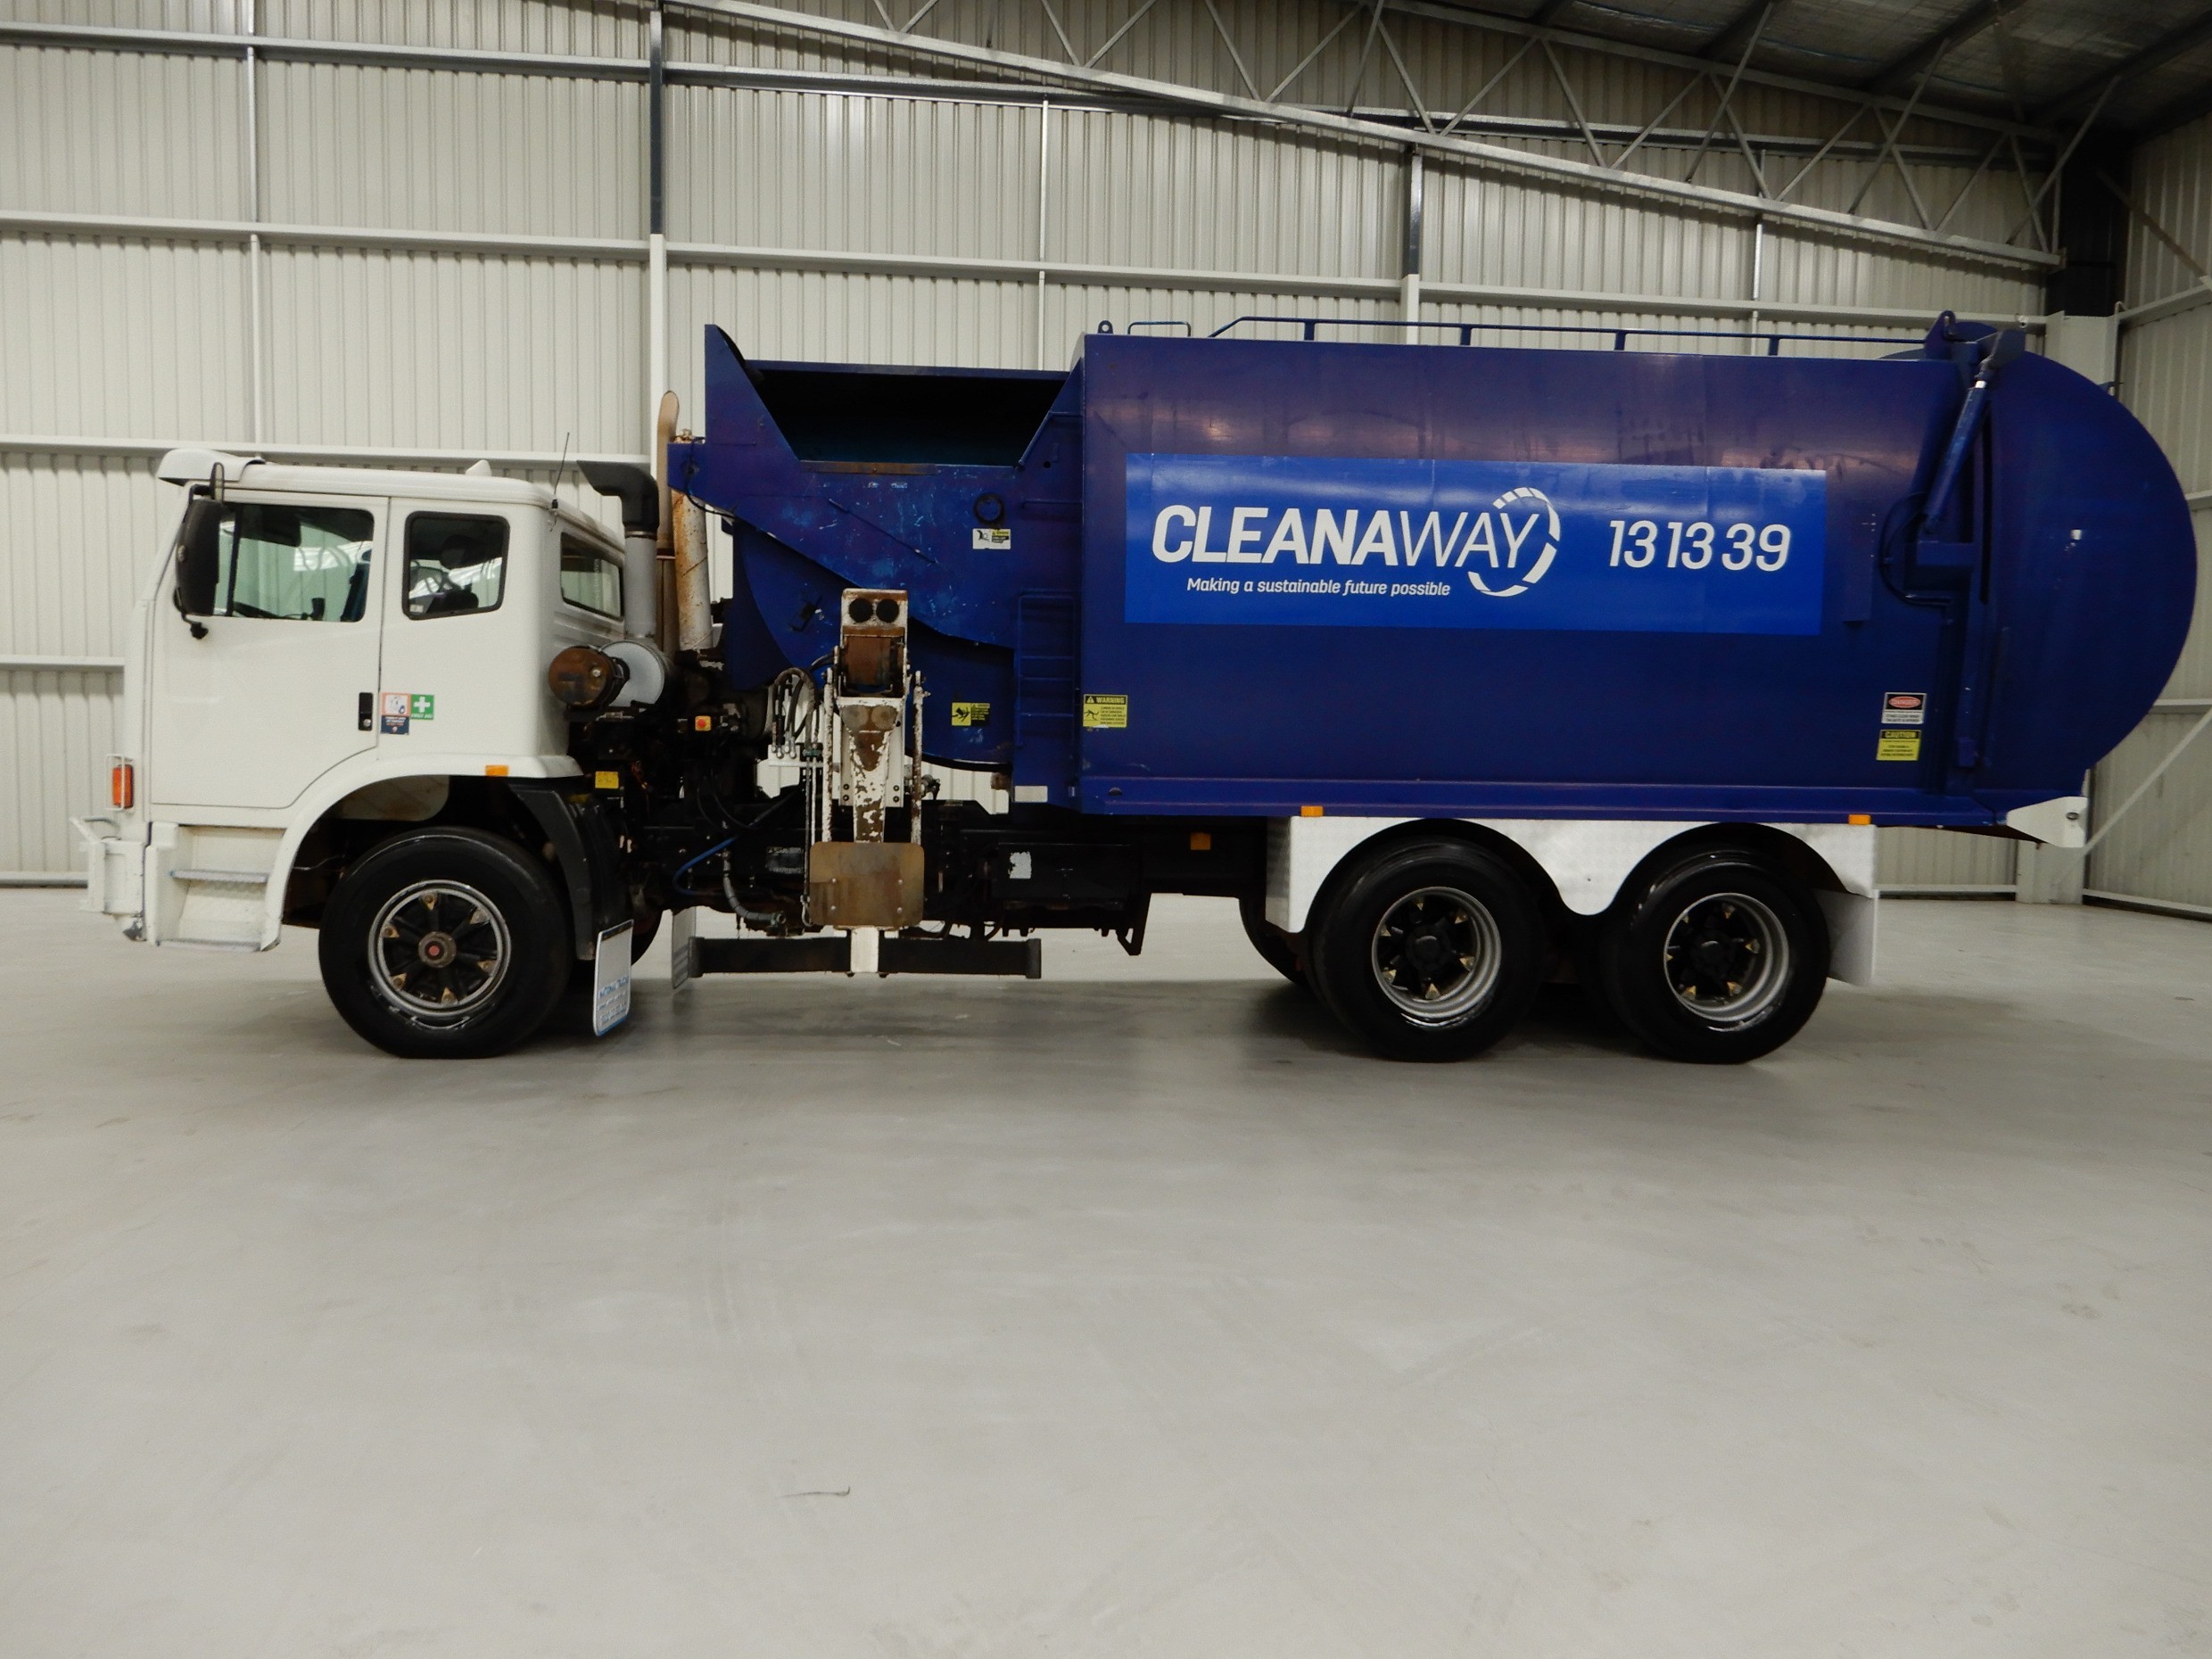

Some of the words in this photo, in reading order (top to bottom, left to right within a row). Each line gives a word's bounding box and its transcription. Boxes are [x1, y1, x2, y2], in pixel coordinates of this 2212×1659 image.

[1151, 504, 1539, 568] CLEANAWAY
[1609, 520, 1658, 568] 13
[1667, 521, 1715, 570] 13
[1721, 523, 1791, 572] 39
[1187, 577, 1240, 594] Making
[1243, 581, 1253, 592] a
[1257, 579, 1341, 594] sustainable
[1342, 579, 1388, 597] future
[1391, 582, 1451, 597] possible
